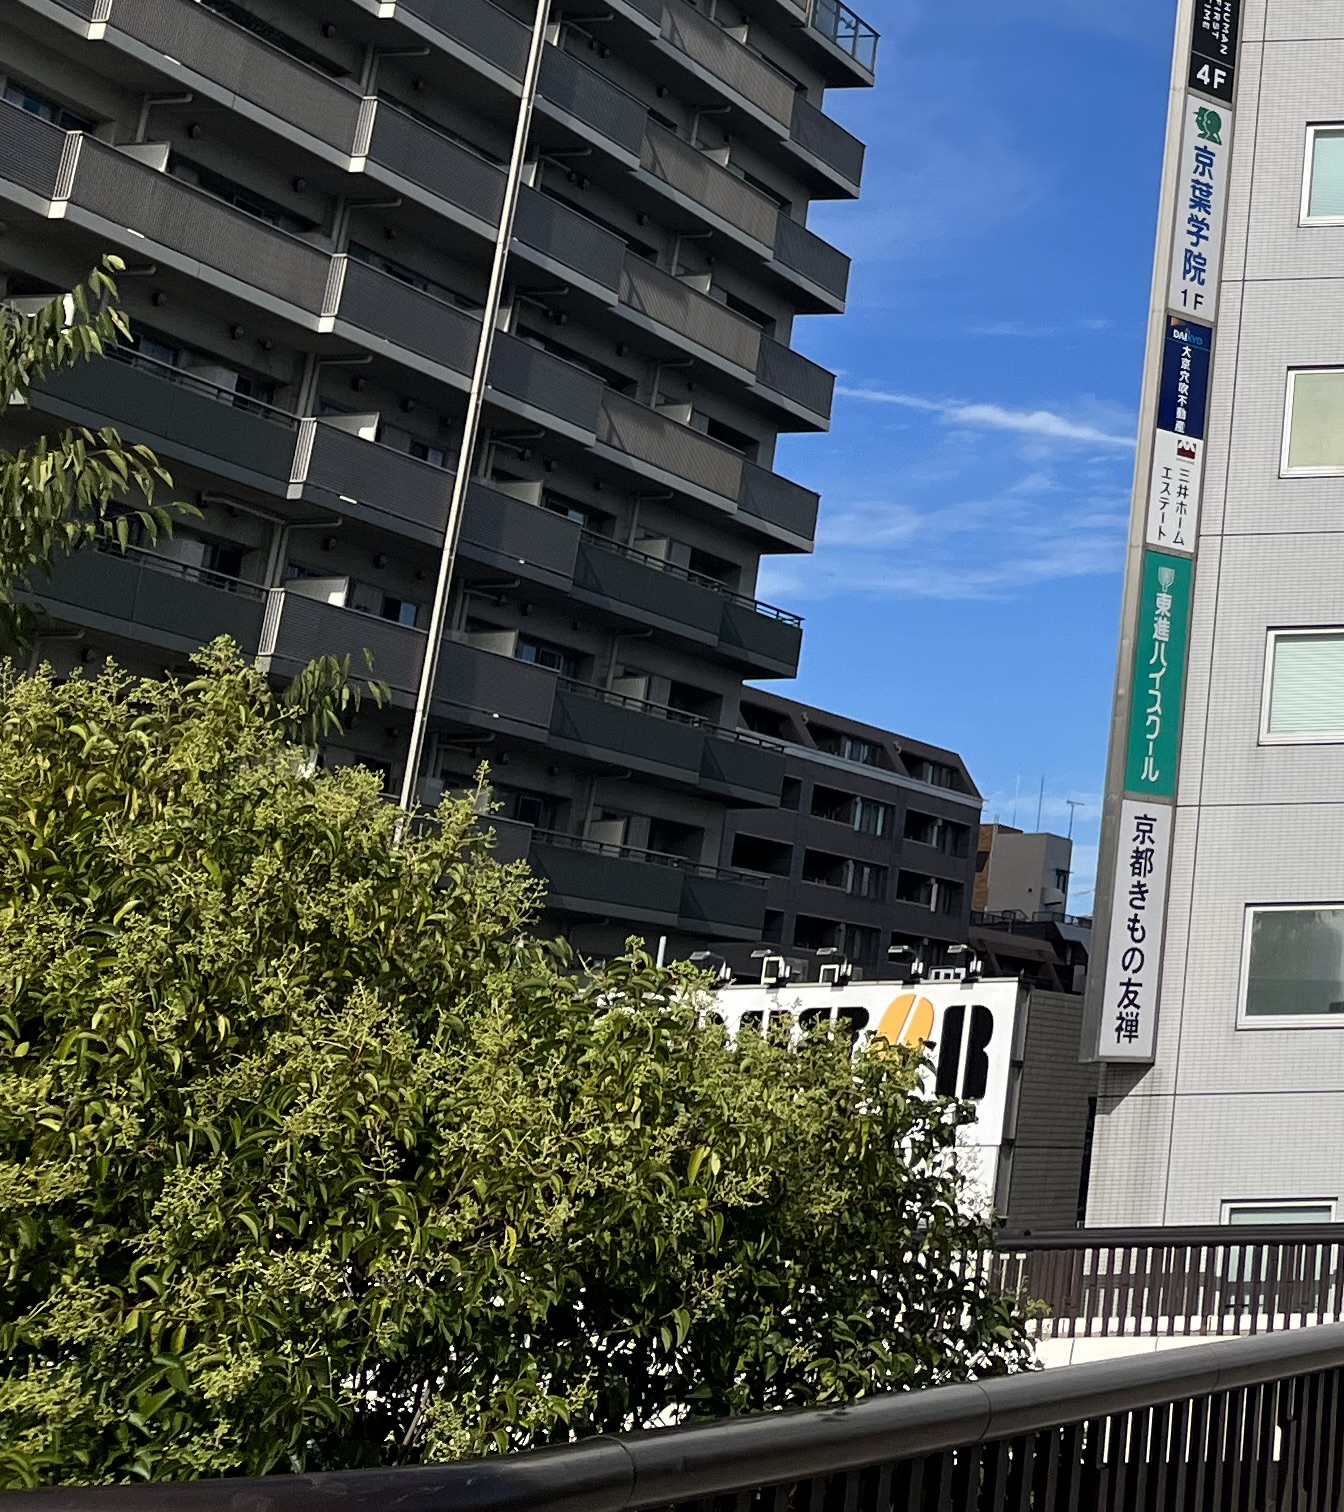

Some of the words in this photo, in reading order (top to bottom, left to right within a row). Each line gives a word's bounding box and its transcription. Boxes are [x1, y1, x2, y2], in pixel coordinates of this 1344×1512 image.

[1219, 1, 1232, 55] HUMAN
[1196, 64, 1227, 89] 4F
[1182, 145, 1216, 286] 京葉学院
[1181, 289, 1205, 311] 1F
[1158, 466, 1173, 540] エステート
[1172, 468, 1190, 546] 三井ホーム
[1141, 592, 1172, 782] 東進ハイスクール
[1115, 814, 1157, 1044] 京都きもの友禅
